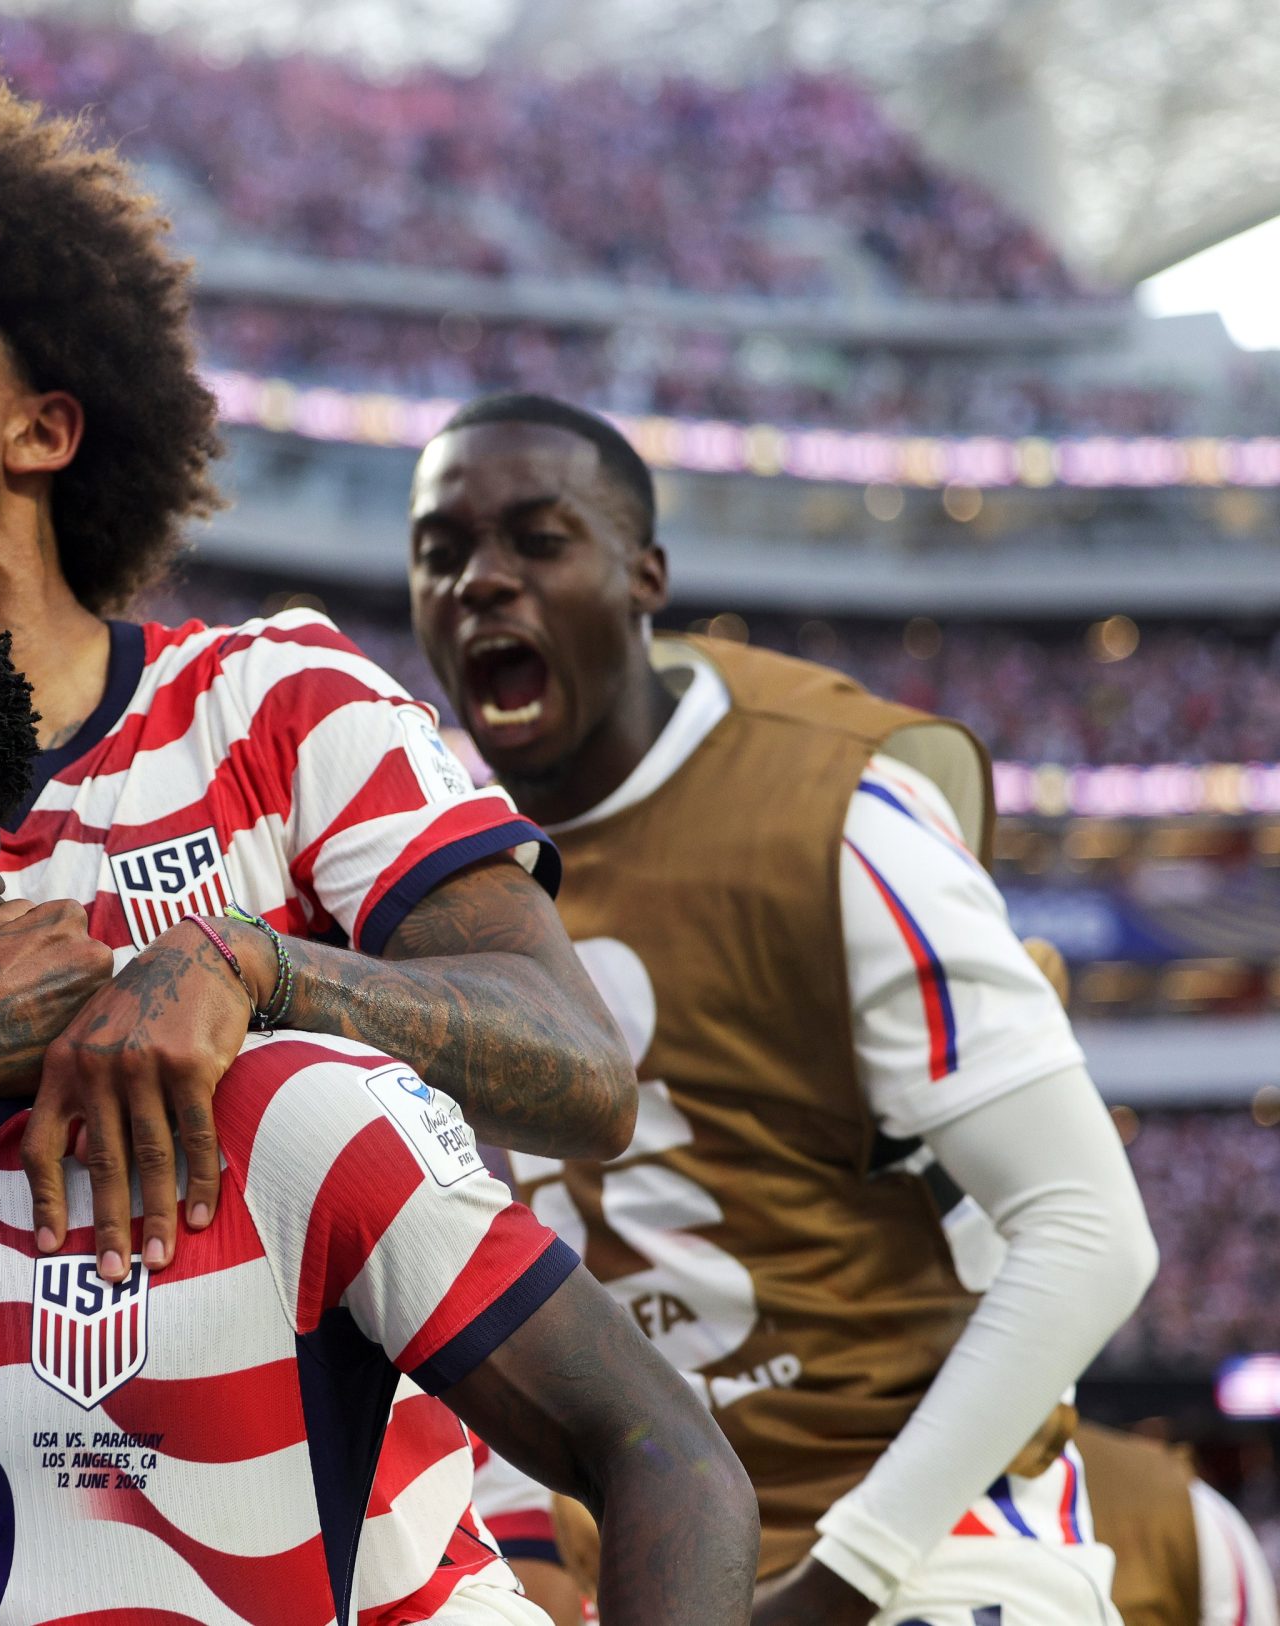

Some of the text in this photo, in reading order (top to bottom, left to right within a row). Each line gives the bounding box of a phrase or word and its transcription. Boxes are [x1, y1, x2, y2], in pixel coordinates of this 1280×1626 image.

[120, 836, 215, 894] USA
[458, 1151, 474, 1167] FIFA
[42, 1261, 142, 1317] USA
[630, 1291, 699, 1341] FA
[32, 1431, 165, 1449] USA VS. PARAGUAY
[41, 1452, 158, 1471] LOS ANGELES, CA
[57, 1472, 148, 1490] 12 JUNE 2026
